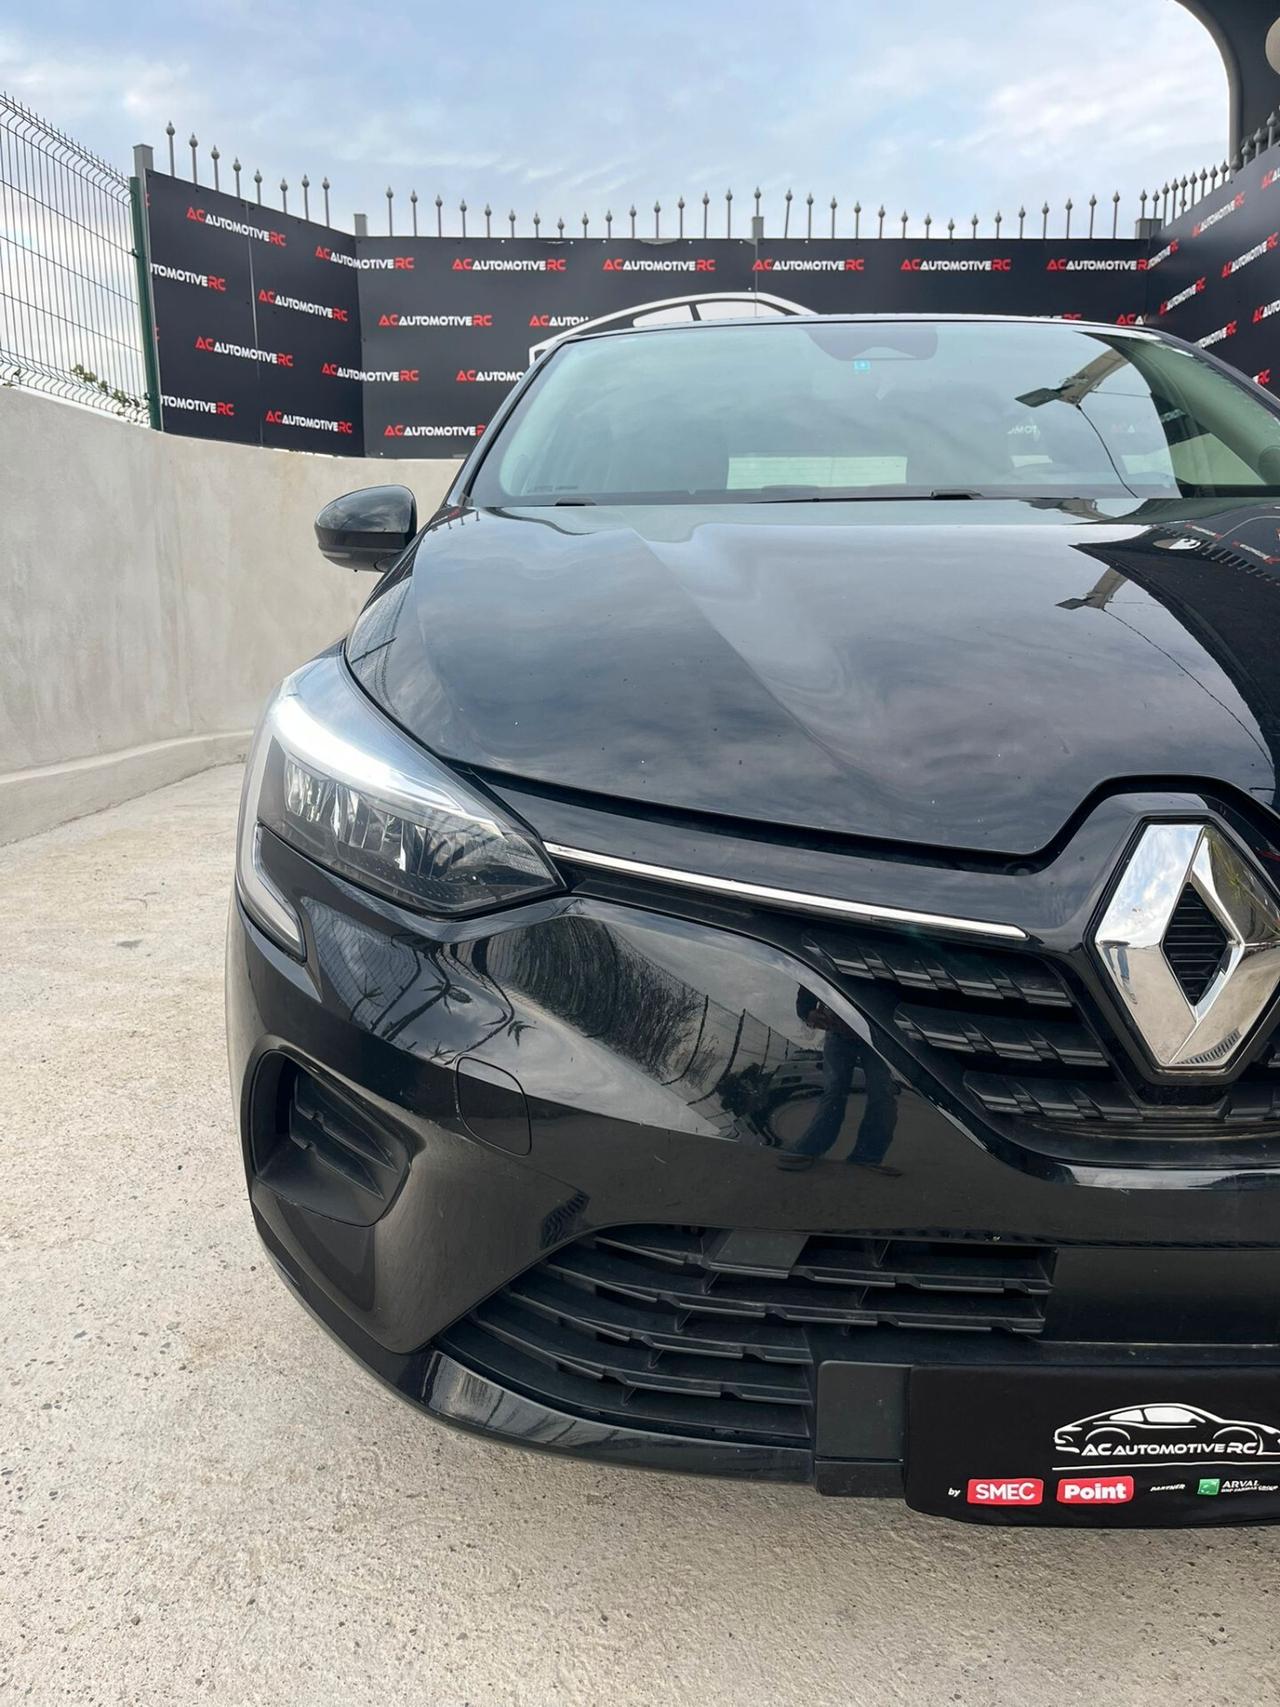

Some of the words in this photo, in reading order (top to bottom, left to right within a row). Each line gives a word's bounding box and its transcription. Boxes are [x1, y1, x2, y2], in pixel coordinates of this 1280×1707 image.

[186, 206, 287, 248] ACAUTOMOTIVERC
[315, 245, 415, 270] ACAUTOMOTIVERC
[452, 258, 567, 272] ACAUTOMOTIVERC
[603, 258, 716, 272] ACAUTOMOTIVERC
[752, 258, 865, 272] ACAUTOMOTIVERC
[901, 258, 1012, 272] ACAUTOMOTIVERC
[258, 288, 349, 322] ACAUTOMOTIVERC
[378, 313, 493, 327] ACAUTOMOTIVERC
[195, 335, 294, 368] ACAUTOMOTIVERC
[321, 362, 420, 383] ACAUTOMOTIVERC
[265, 410, 353, 434] ACAUTOMOTIVERC
[948, 1487, 961, 1498] by
[975, 1483, 1036, 1501] SMEC
[1064, 1483, 1127, 1500] Point
